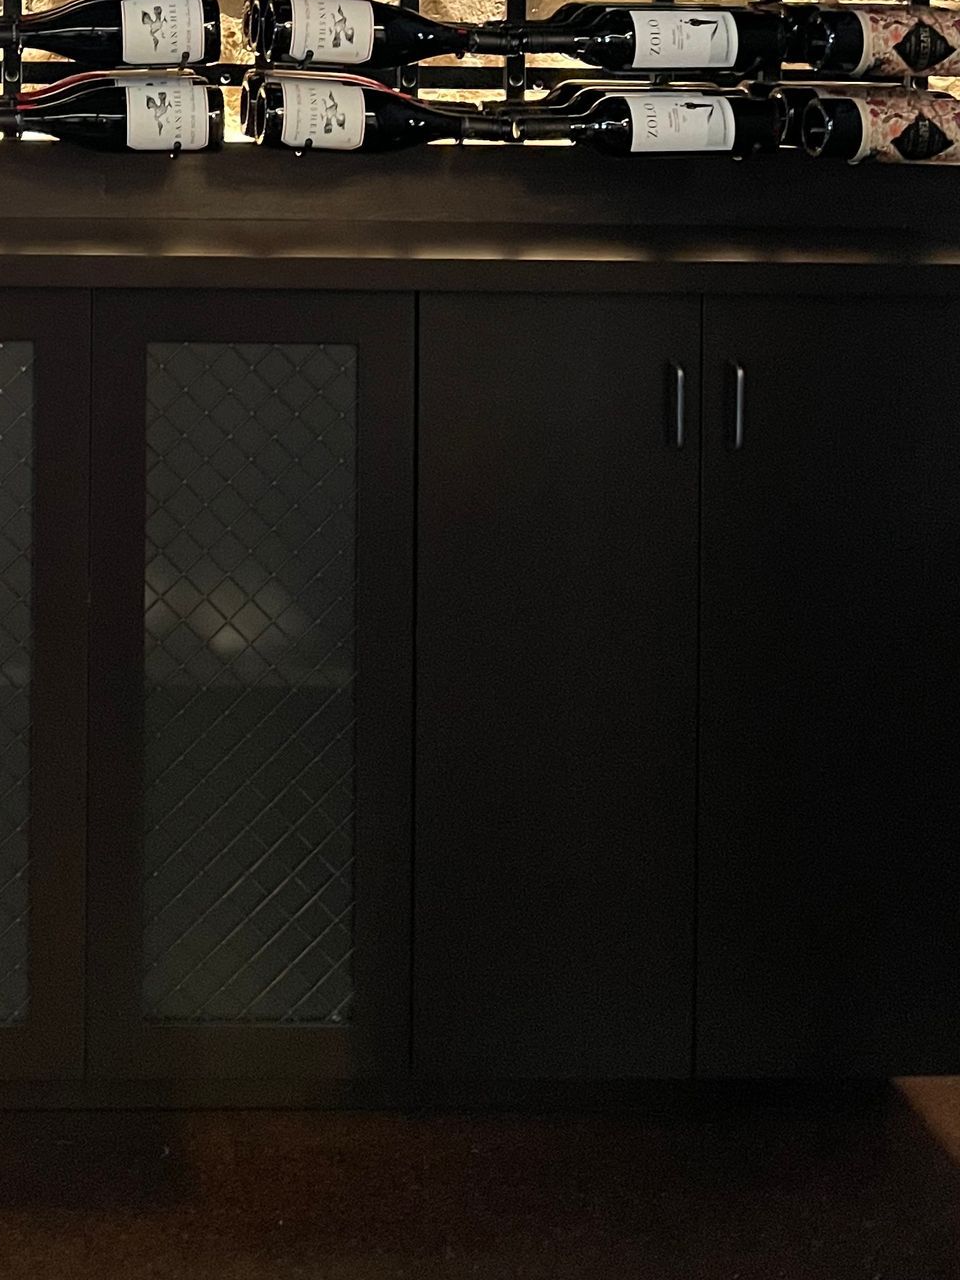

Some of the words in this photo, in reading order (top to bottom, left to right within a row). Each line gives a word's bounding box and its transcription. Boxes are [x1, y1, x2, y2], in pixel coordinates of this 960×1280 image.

[168, 3, 178, 53] BANSHEE
[647, 19, 661, 56] ZOLO
[173, 89, 182, 139] BANSHEE
[643, 103, 658, 139] ZOLO
